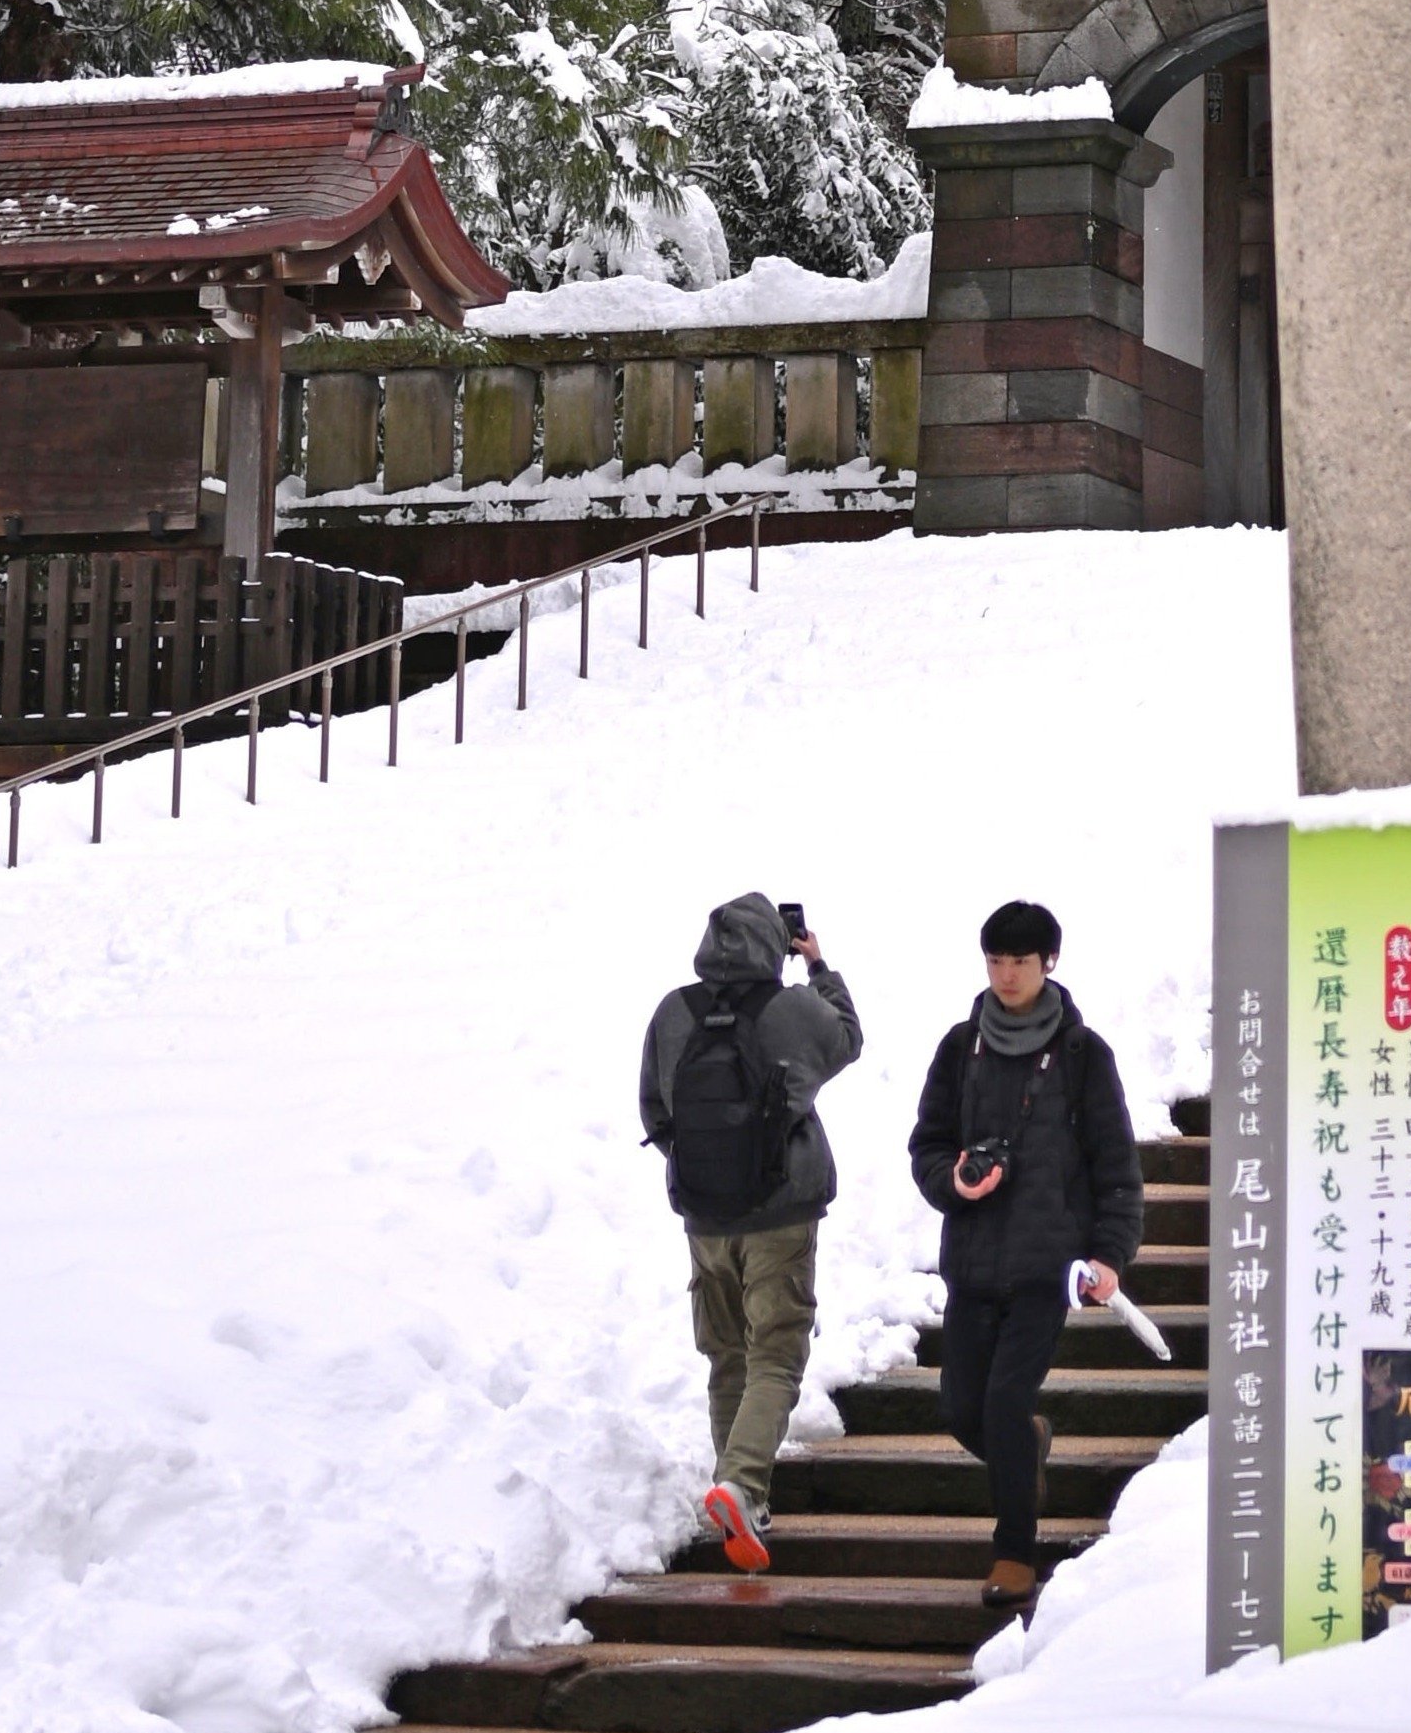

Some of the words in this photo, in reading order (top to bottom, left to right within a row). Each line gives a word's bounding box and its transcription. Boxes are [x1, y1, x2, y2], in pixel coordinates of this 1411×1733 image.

[1237, 988, 1265, 1137] お問合せは
[1369, 1037, 1396, 1098] 女性
[1227, 1157, 1272, 1355] 尾山神社
[1311, 926, 1350, 1642] 還暦長寿祝も受け付けております
